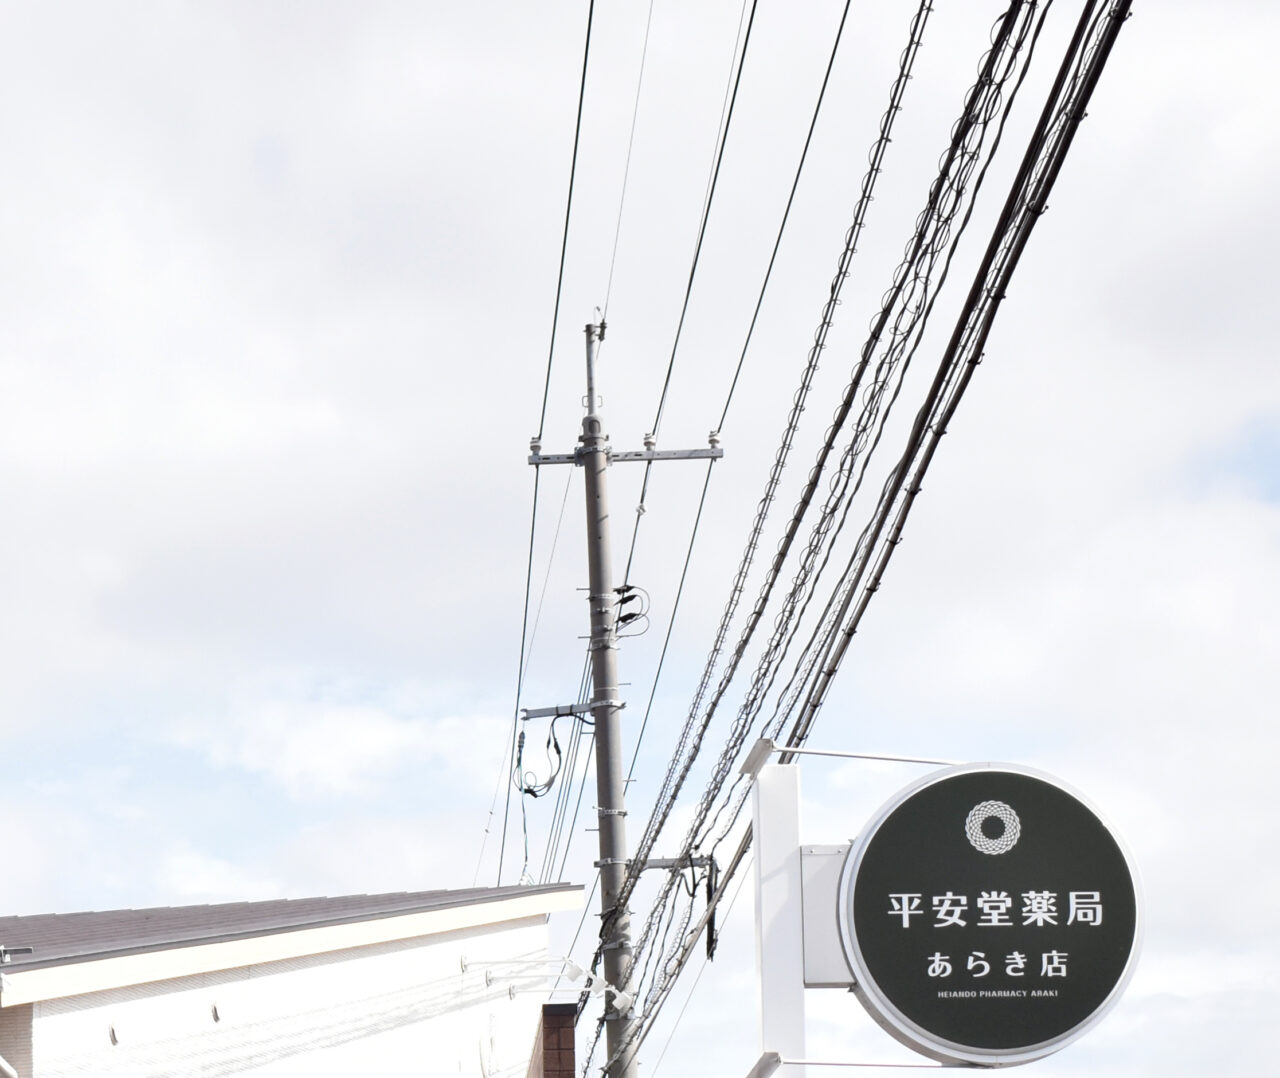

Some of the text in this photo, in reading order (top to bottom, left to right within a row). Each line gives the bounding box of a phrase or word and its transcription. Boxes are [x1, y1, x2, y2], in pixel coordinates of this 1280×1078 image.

[887, 890, 1103, 928] 平安堂薬局
[927, 950, 1068, 977] あらき店
[980, 990, 1027, 998] PHARMACY
[1031, 989, 1058, 997] ARAKI
